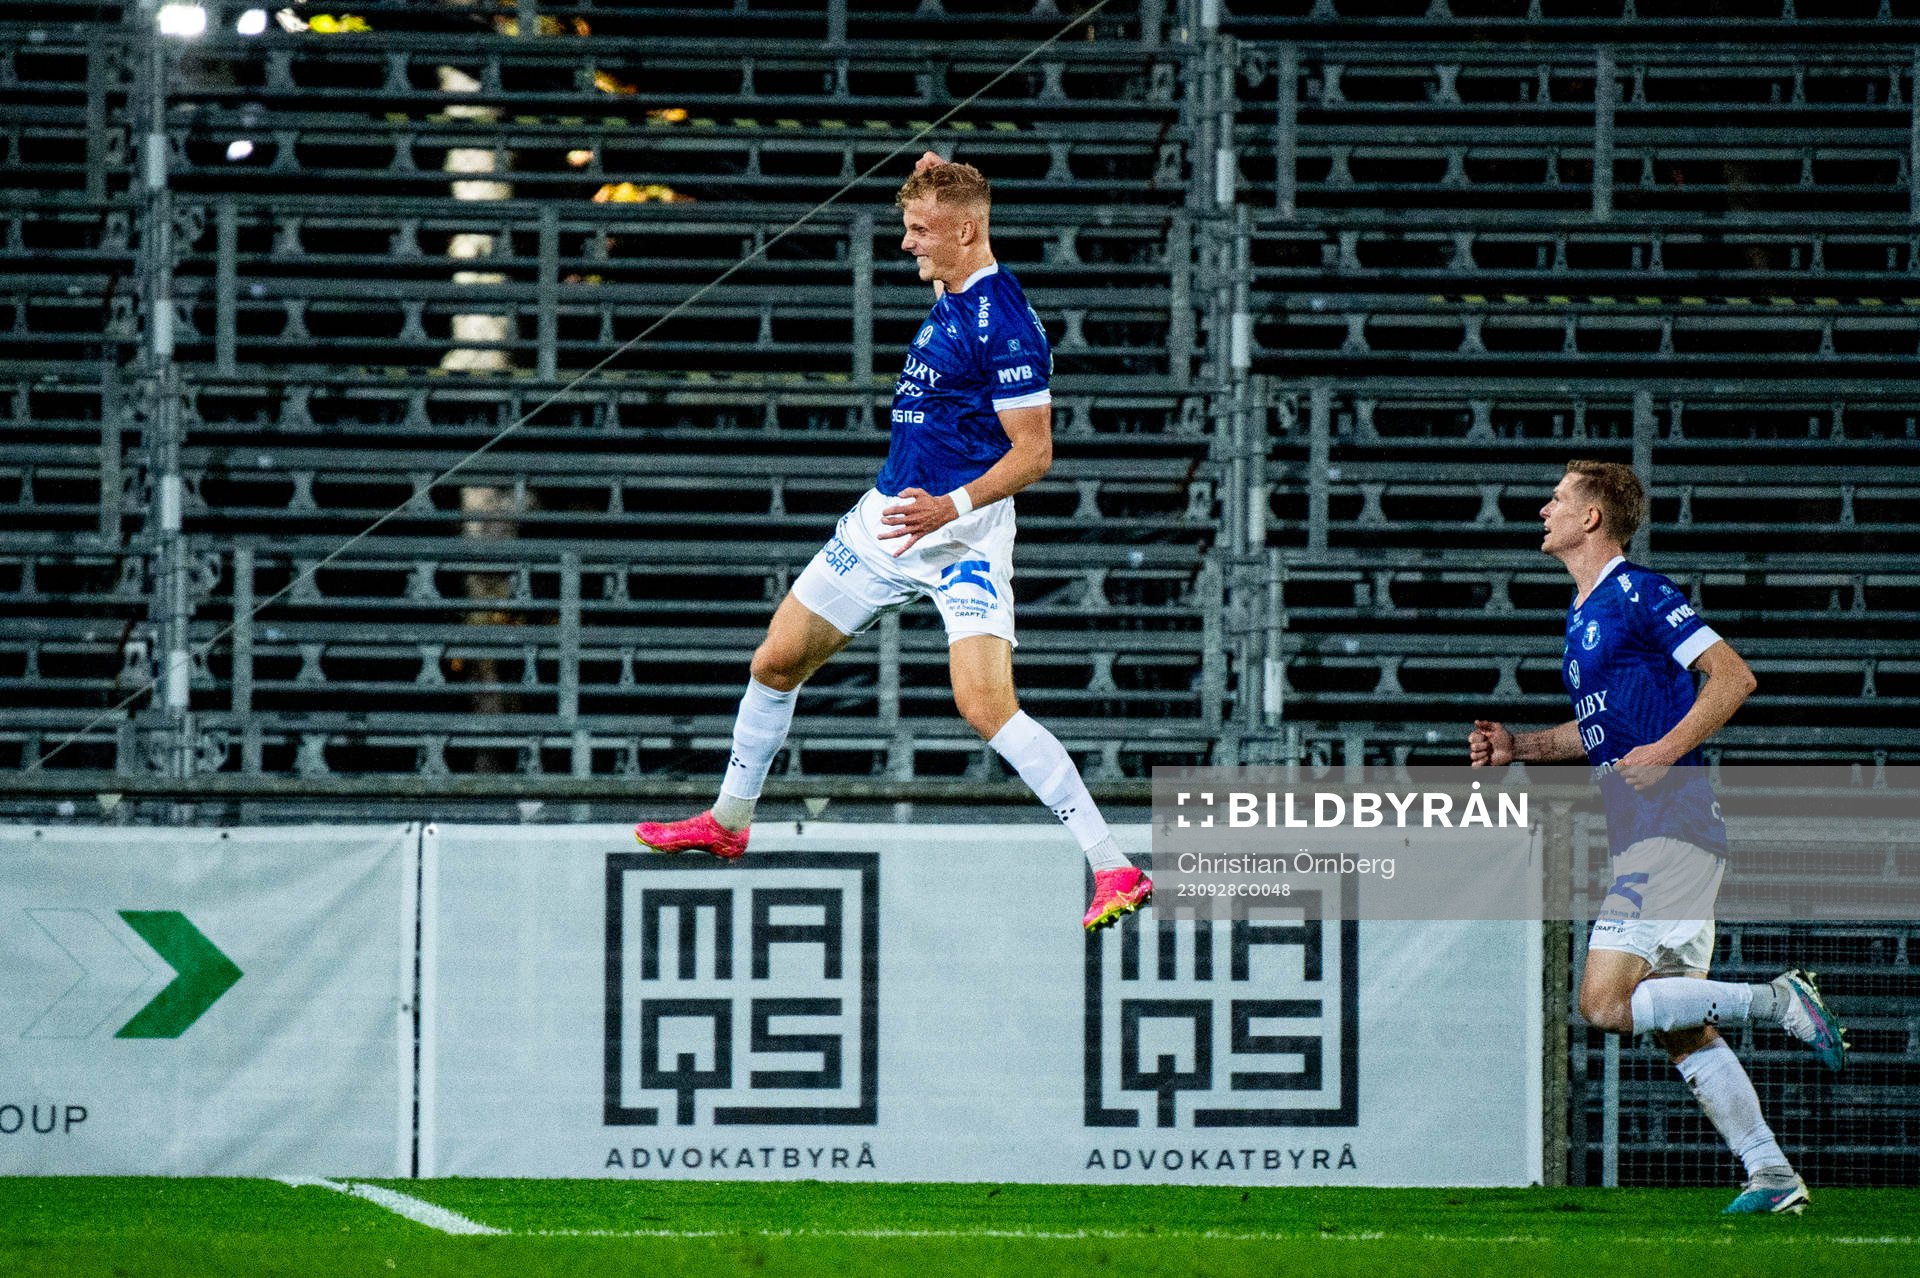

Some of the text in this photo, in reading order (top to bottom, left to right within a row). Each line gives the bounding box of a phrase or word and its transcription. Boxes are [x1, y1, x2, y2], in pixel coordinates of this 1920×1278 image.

[978, 296, 992, 328] akea
[998, 365, 1034, 384] MVB
[1665, 604, 1696, 629] MVB
[605, 1143, 878, 1169] ADVOKATBYRÅ
[1086, 1143, 1359, 1171] ADVOKATBYRÅ
